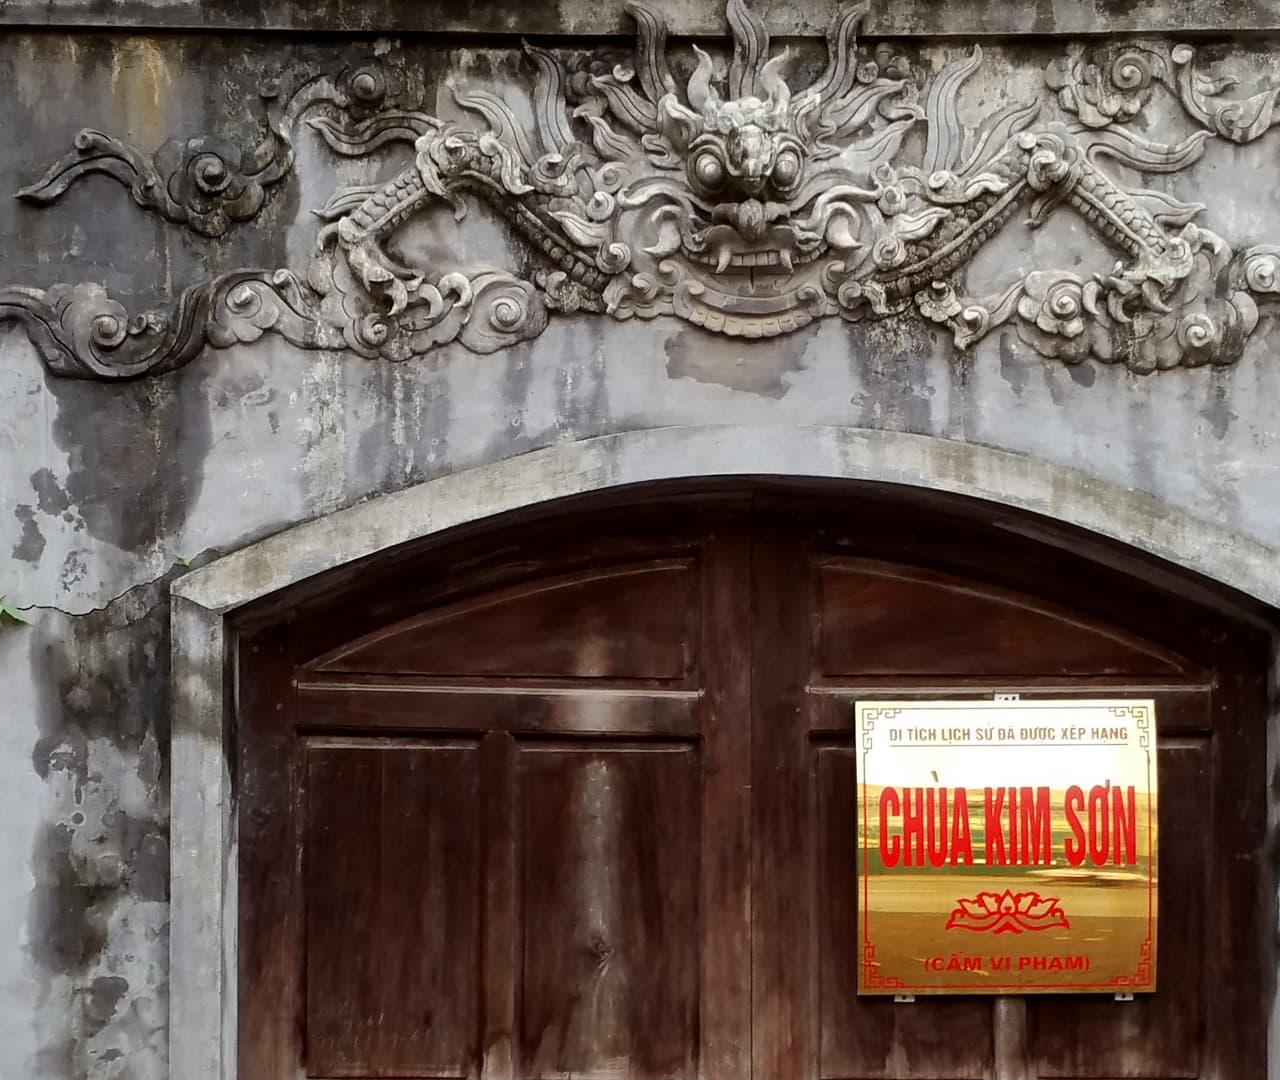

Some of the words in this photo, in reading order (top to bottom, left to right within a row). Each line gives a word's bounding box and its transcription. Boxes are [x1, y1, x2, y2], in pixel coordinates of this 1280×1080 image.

[889, 728, 902, 741] DI
[907, 725, 936, 741] TÍCH
[941, 728, 970, 744] LỊCH
[998, 725, 1015, 741] ĐÃ
[1020, 726, 1055, 743] ĐƯỢC
[1091, 727, 1128, 743] HẠNG
[878, 771, 973, 869] CHÙA
[984, 786, 1052, 867] KIM
[1064, 779, 1137, 867] SƠN
[990, 956, 1011, 971] VI
[1018, 955, 1091, 974] PHẠM)
